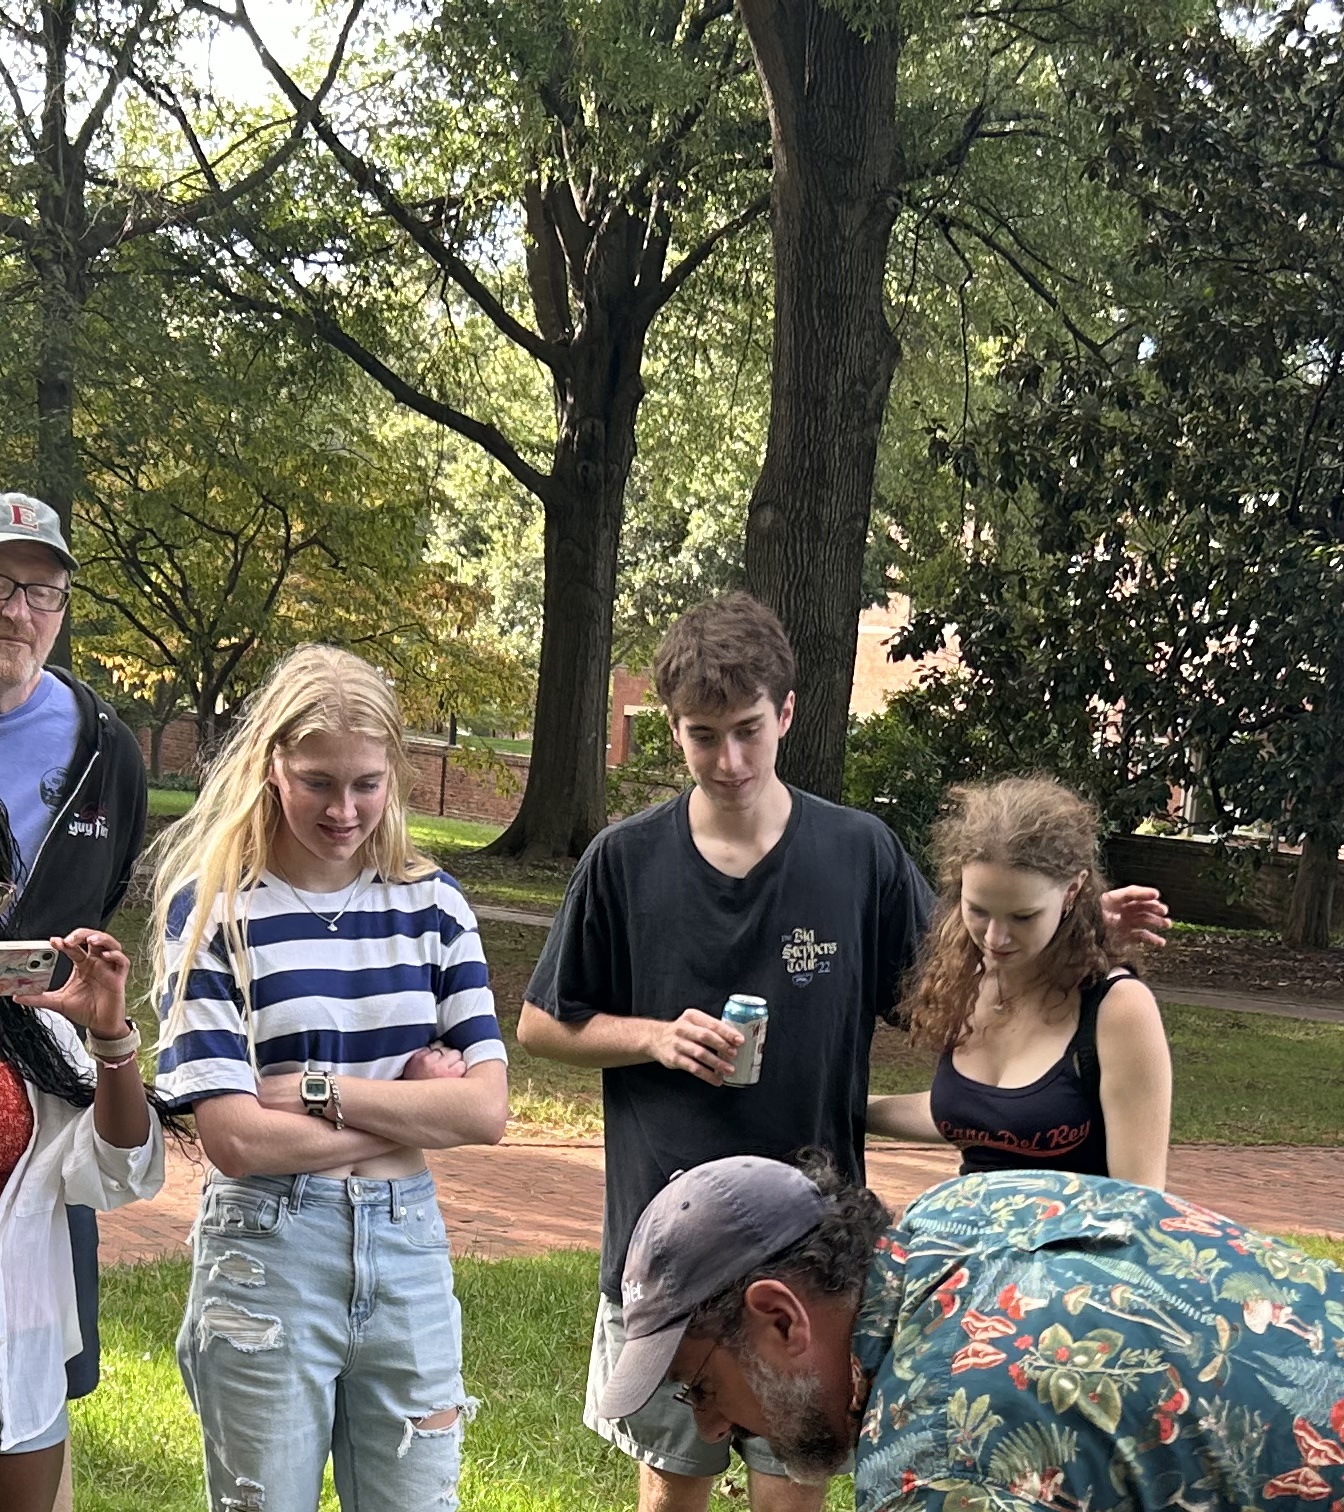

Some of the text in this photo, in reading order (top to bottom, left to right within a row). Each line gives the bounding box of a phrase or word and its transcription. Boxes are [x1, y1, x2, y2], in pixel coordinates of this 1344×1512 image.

[10, 503, 39, 531] E
[67, 817, 93, 838] guy
[792, 926, 815, 943] Big
[781, 942, 837, 960] Steppers
[787, 958, 818, 974] Tour
[997, 1130, 1041, 1151] Del
[1046, 1119, 1091, 1149] Rey
